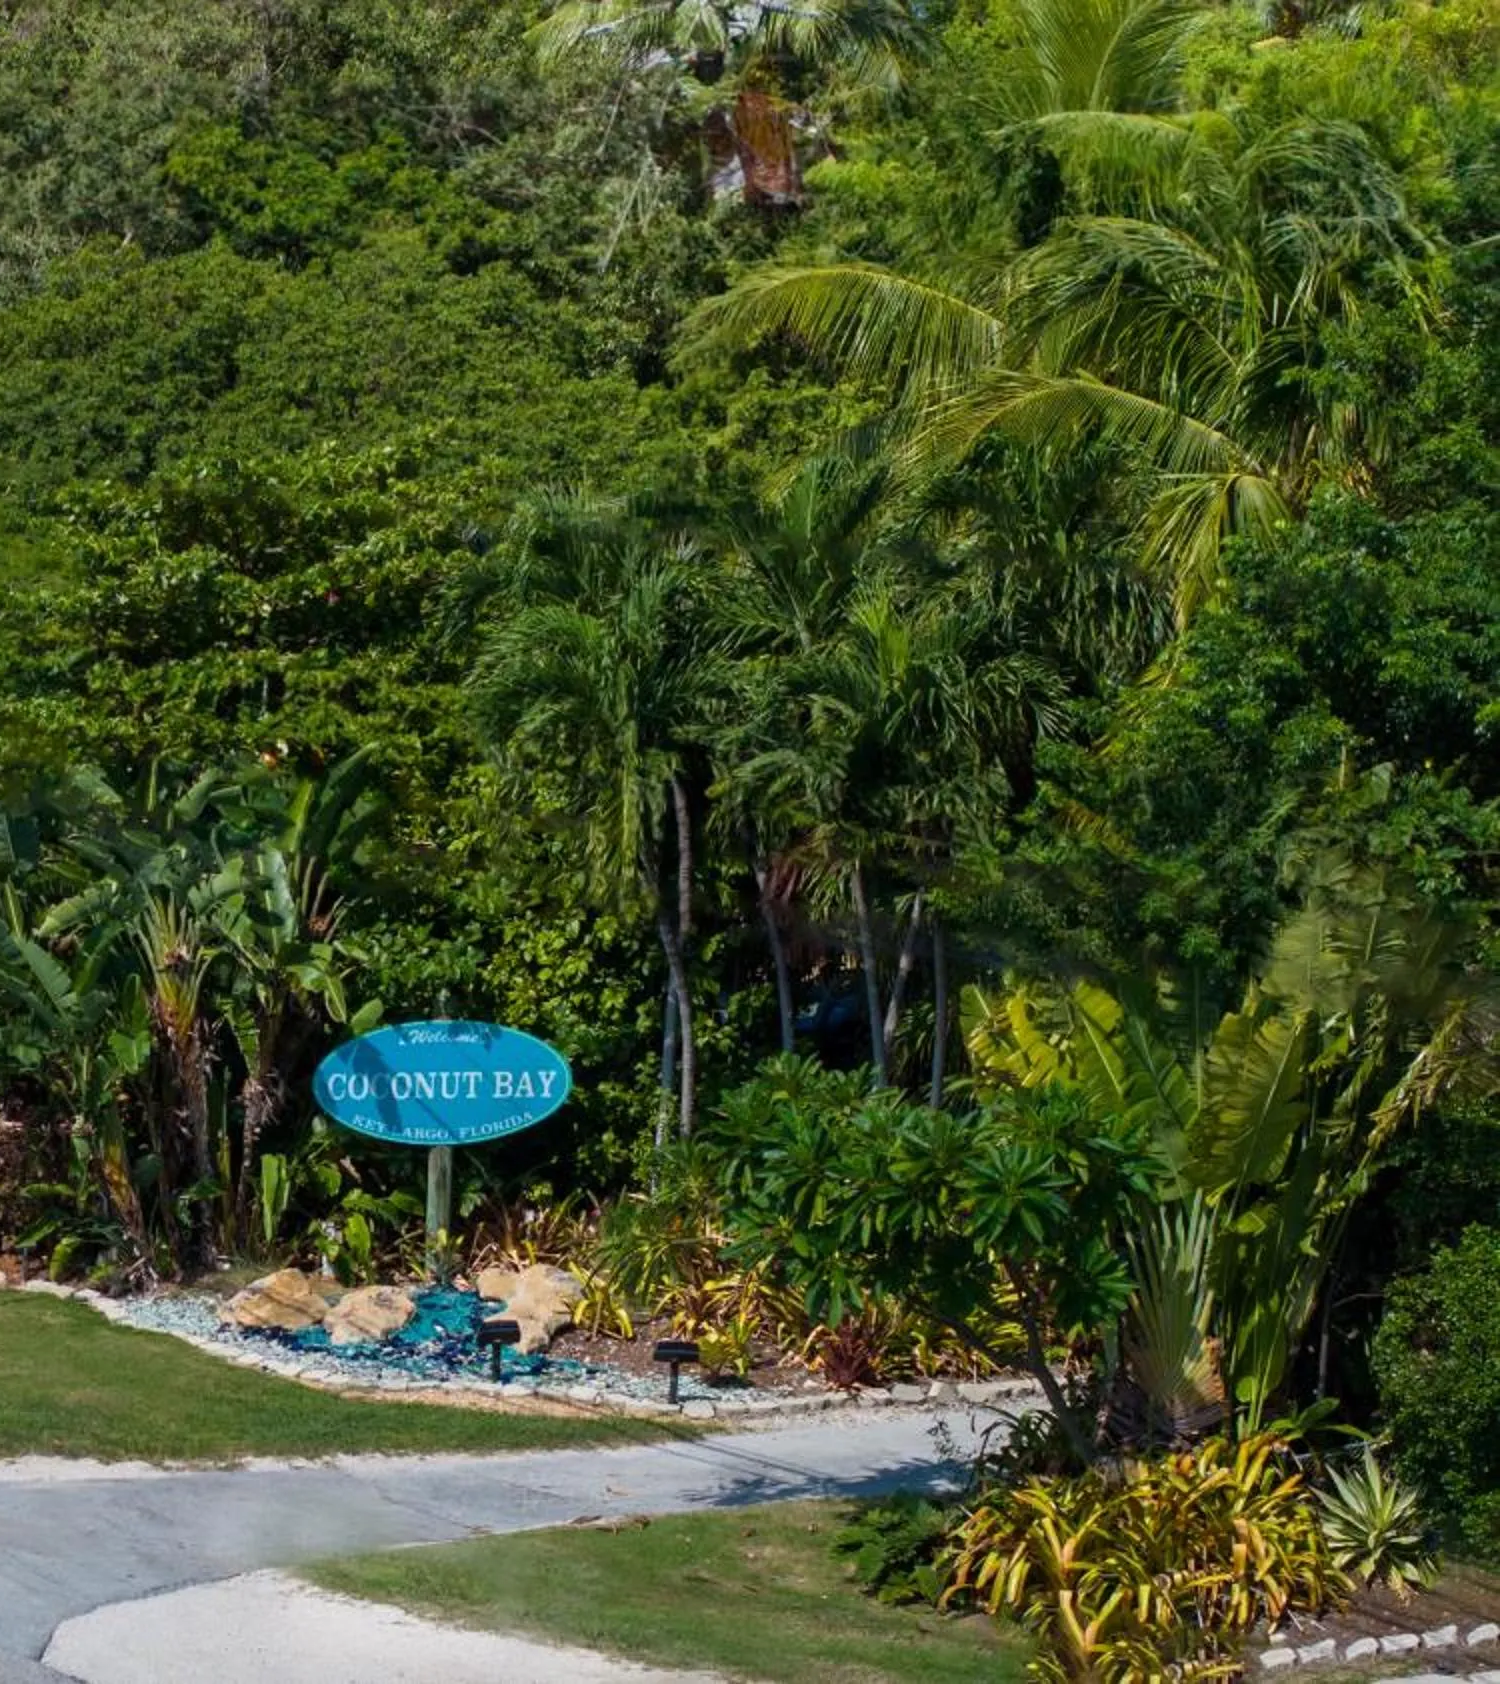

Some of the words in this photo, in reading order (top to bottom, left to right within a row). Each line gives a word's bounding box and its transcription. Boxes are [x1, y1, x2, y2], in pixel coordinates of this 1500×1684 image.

[408, 1029, 479, 1044] Welcme
[327, 1072, 482, 1100] COCONUT
[493, 1071, 556, 1099] BAY
[353, 1114, 387, 1134] KEY
[459, 1112, 533, 1138] FLORIDA
